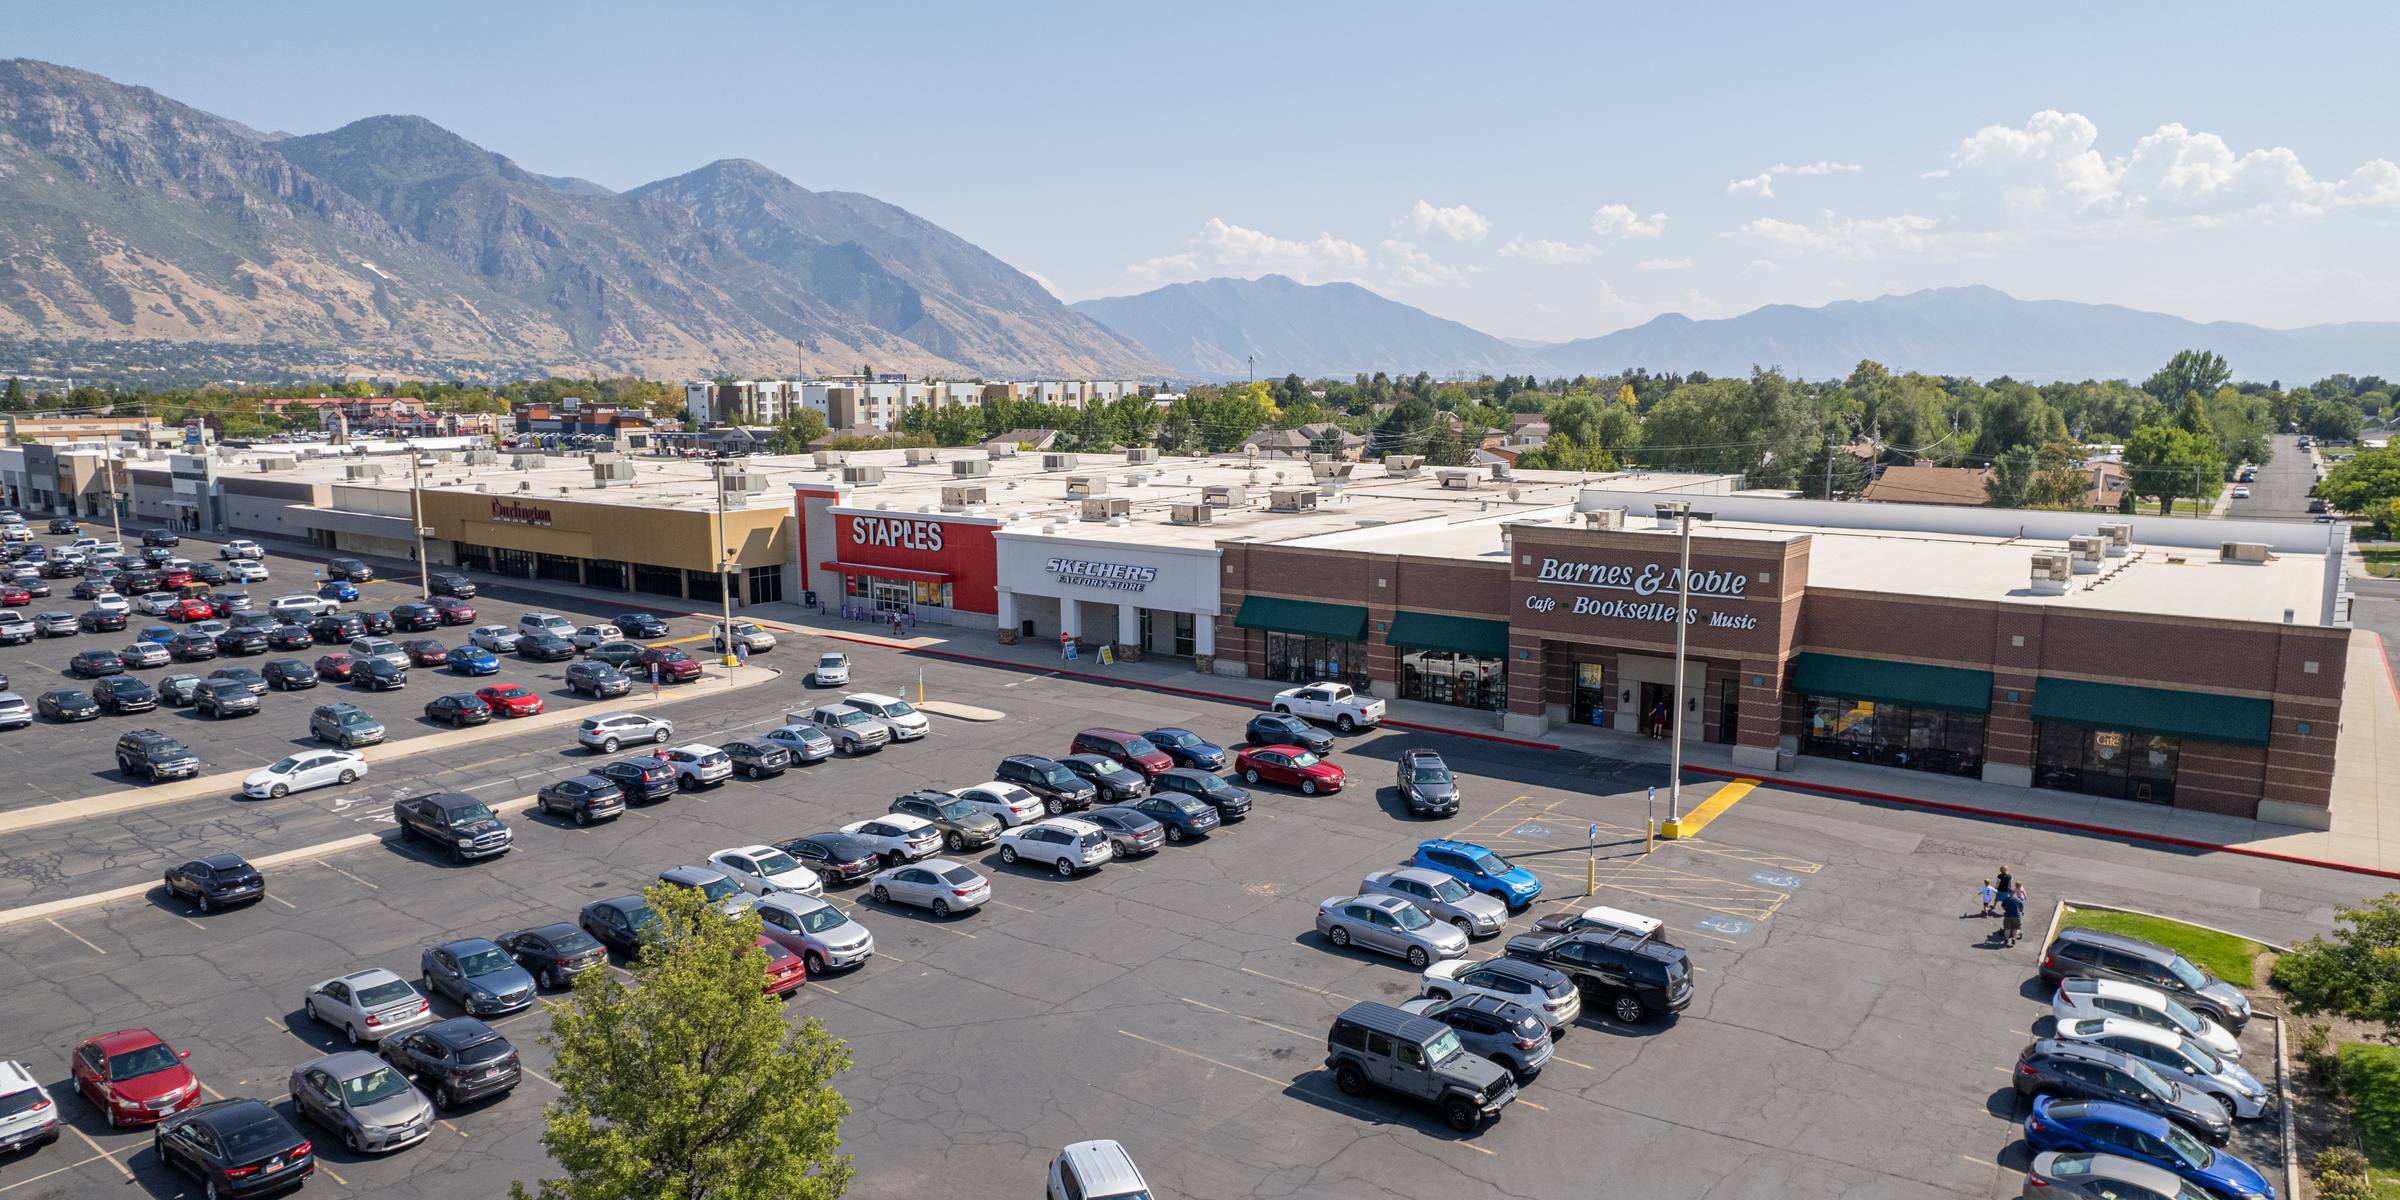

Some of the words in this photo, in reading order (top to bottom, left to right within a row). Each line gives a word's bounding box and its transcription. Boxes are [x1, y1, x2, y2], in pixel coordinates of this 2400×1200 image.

[491, 497, 551, 525] Burlington
[852, 516, 943, 552] STAPLES
[1046, 558, 1157, 582] SKECHERS
[1057, 575, 1106, 588] FACTORY
[1107, 581, 1145, 592] STORE
[1538, 558, 1633, 586] Barnes
[1633, 563, 1665, 596] &
[1666, 567, 1747, 594] Noble
[1525, 595, 1556, 612] Cafe
[1709, 611, 1757, 630] Music
